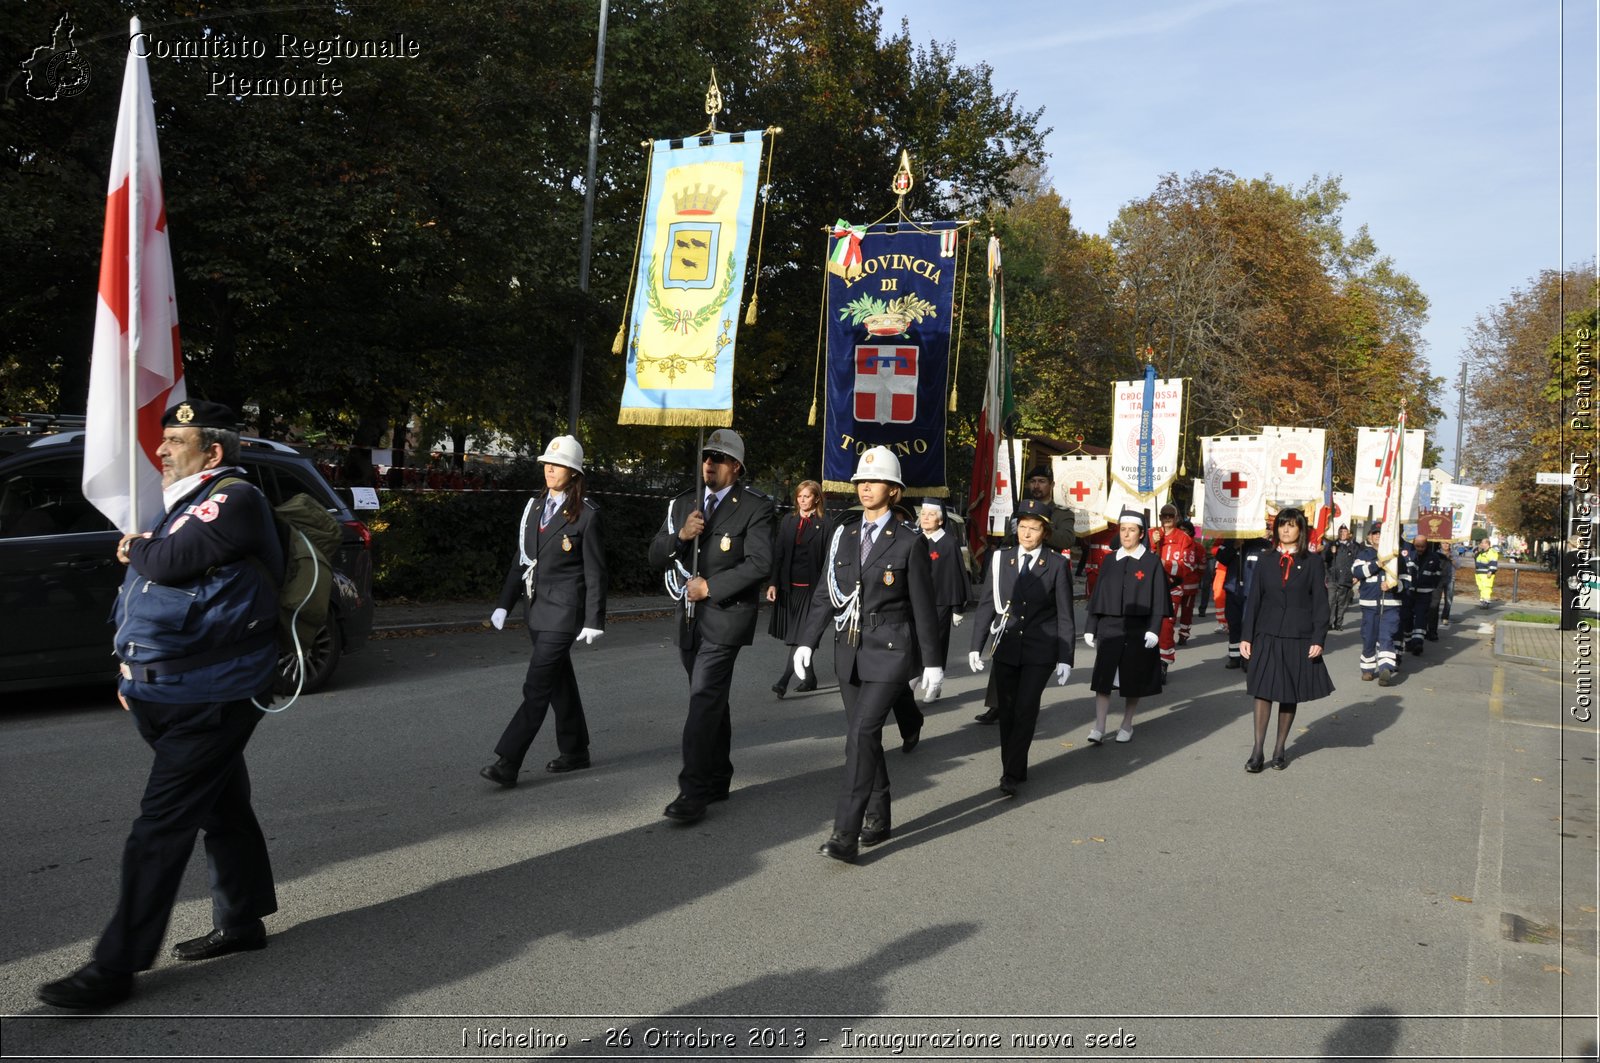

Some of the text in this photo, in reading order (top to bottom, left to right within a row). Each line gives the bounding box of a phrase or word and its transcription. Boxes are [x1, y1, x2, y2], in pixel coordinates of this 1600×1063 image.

[880, 278, 898, 291] DI
[1120, 391, 1178, 401] CROC OSSA
[1129, 401, 1166, 411] ITANA
